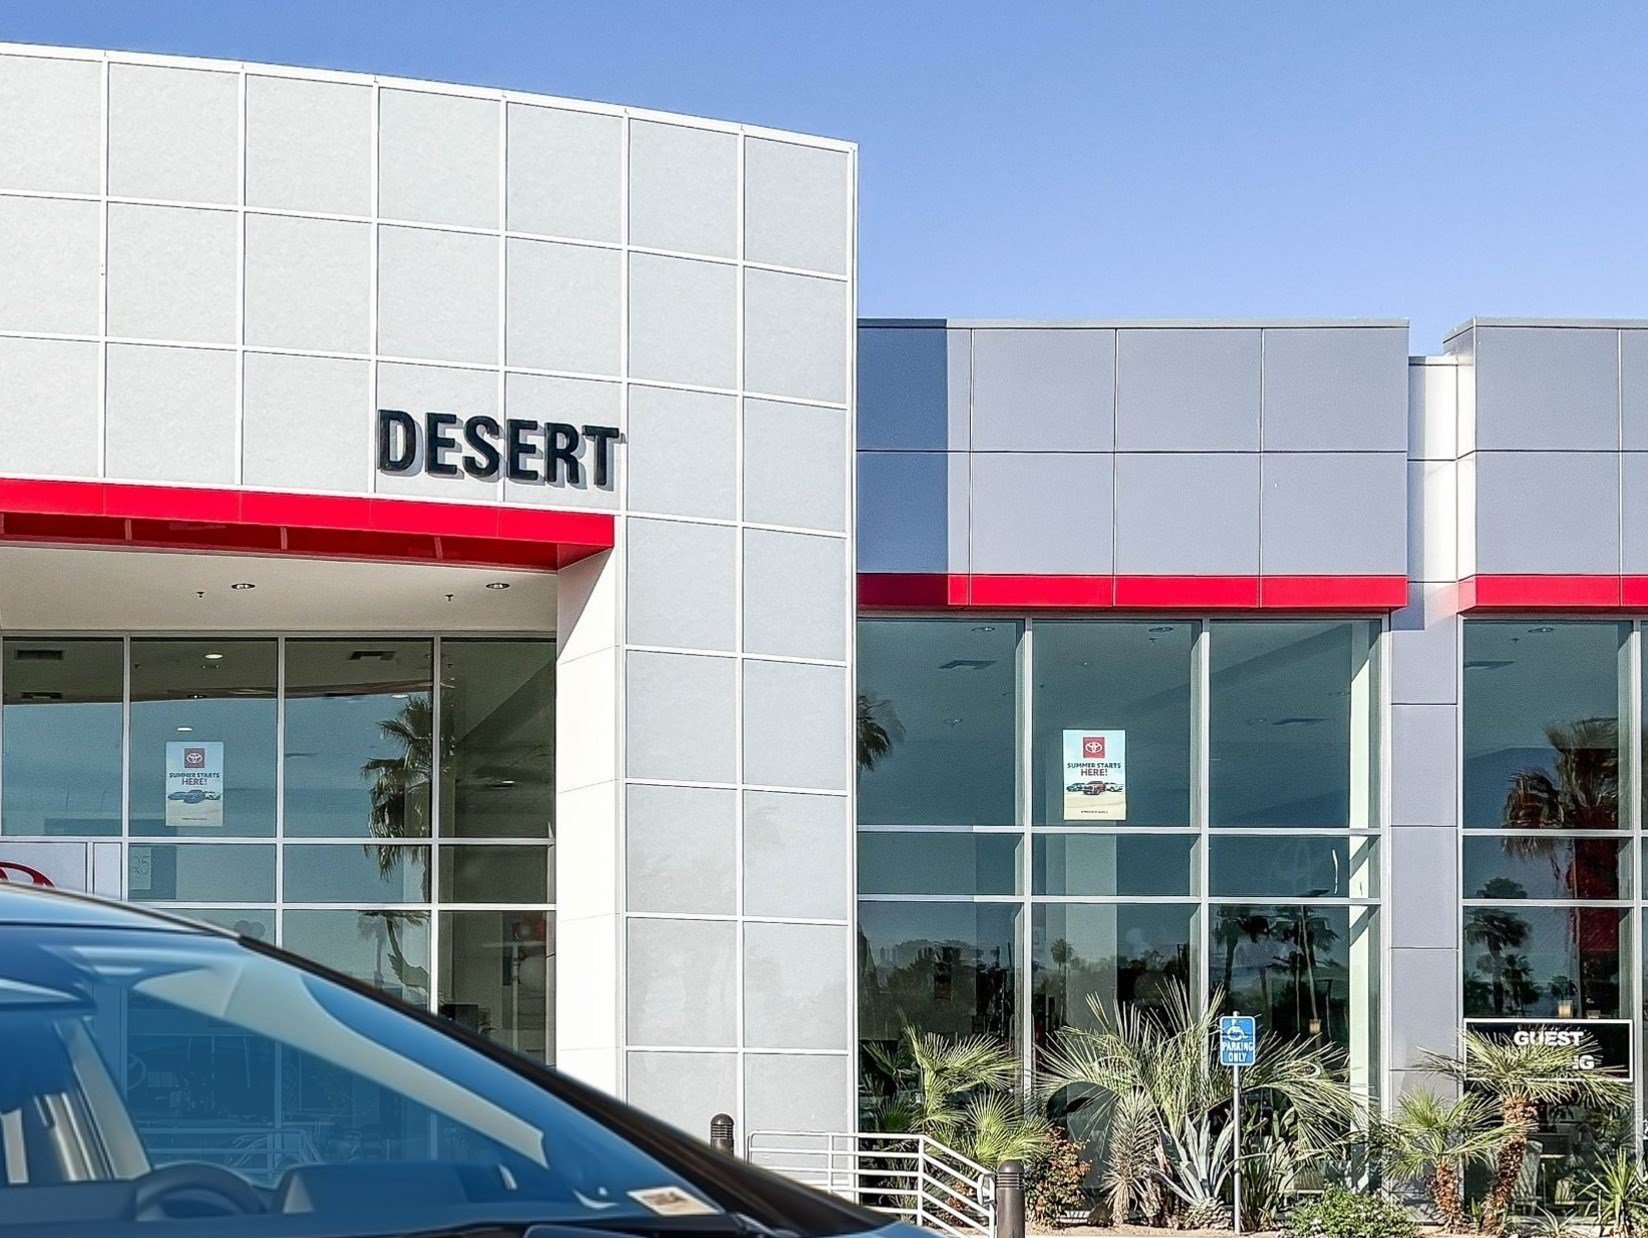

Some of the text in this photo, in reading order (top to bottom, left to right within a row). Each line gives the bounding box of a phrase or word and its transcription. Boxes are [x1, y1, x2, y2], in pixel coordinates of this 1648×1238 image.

[377, 409, 620, 486] DESERT
[181, 778, 207, 786] HERE!
[1513, 1031, 1585, 1046] GUEST
[1222, 1041, 1254, 1052] PARKING
[1228, 1052, 1247, 1062] ONLY
